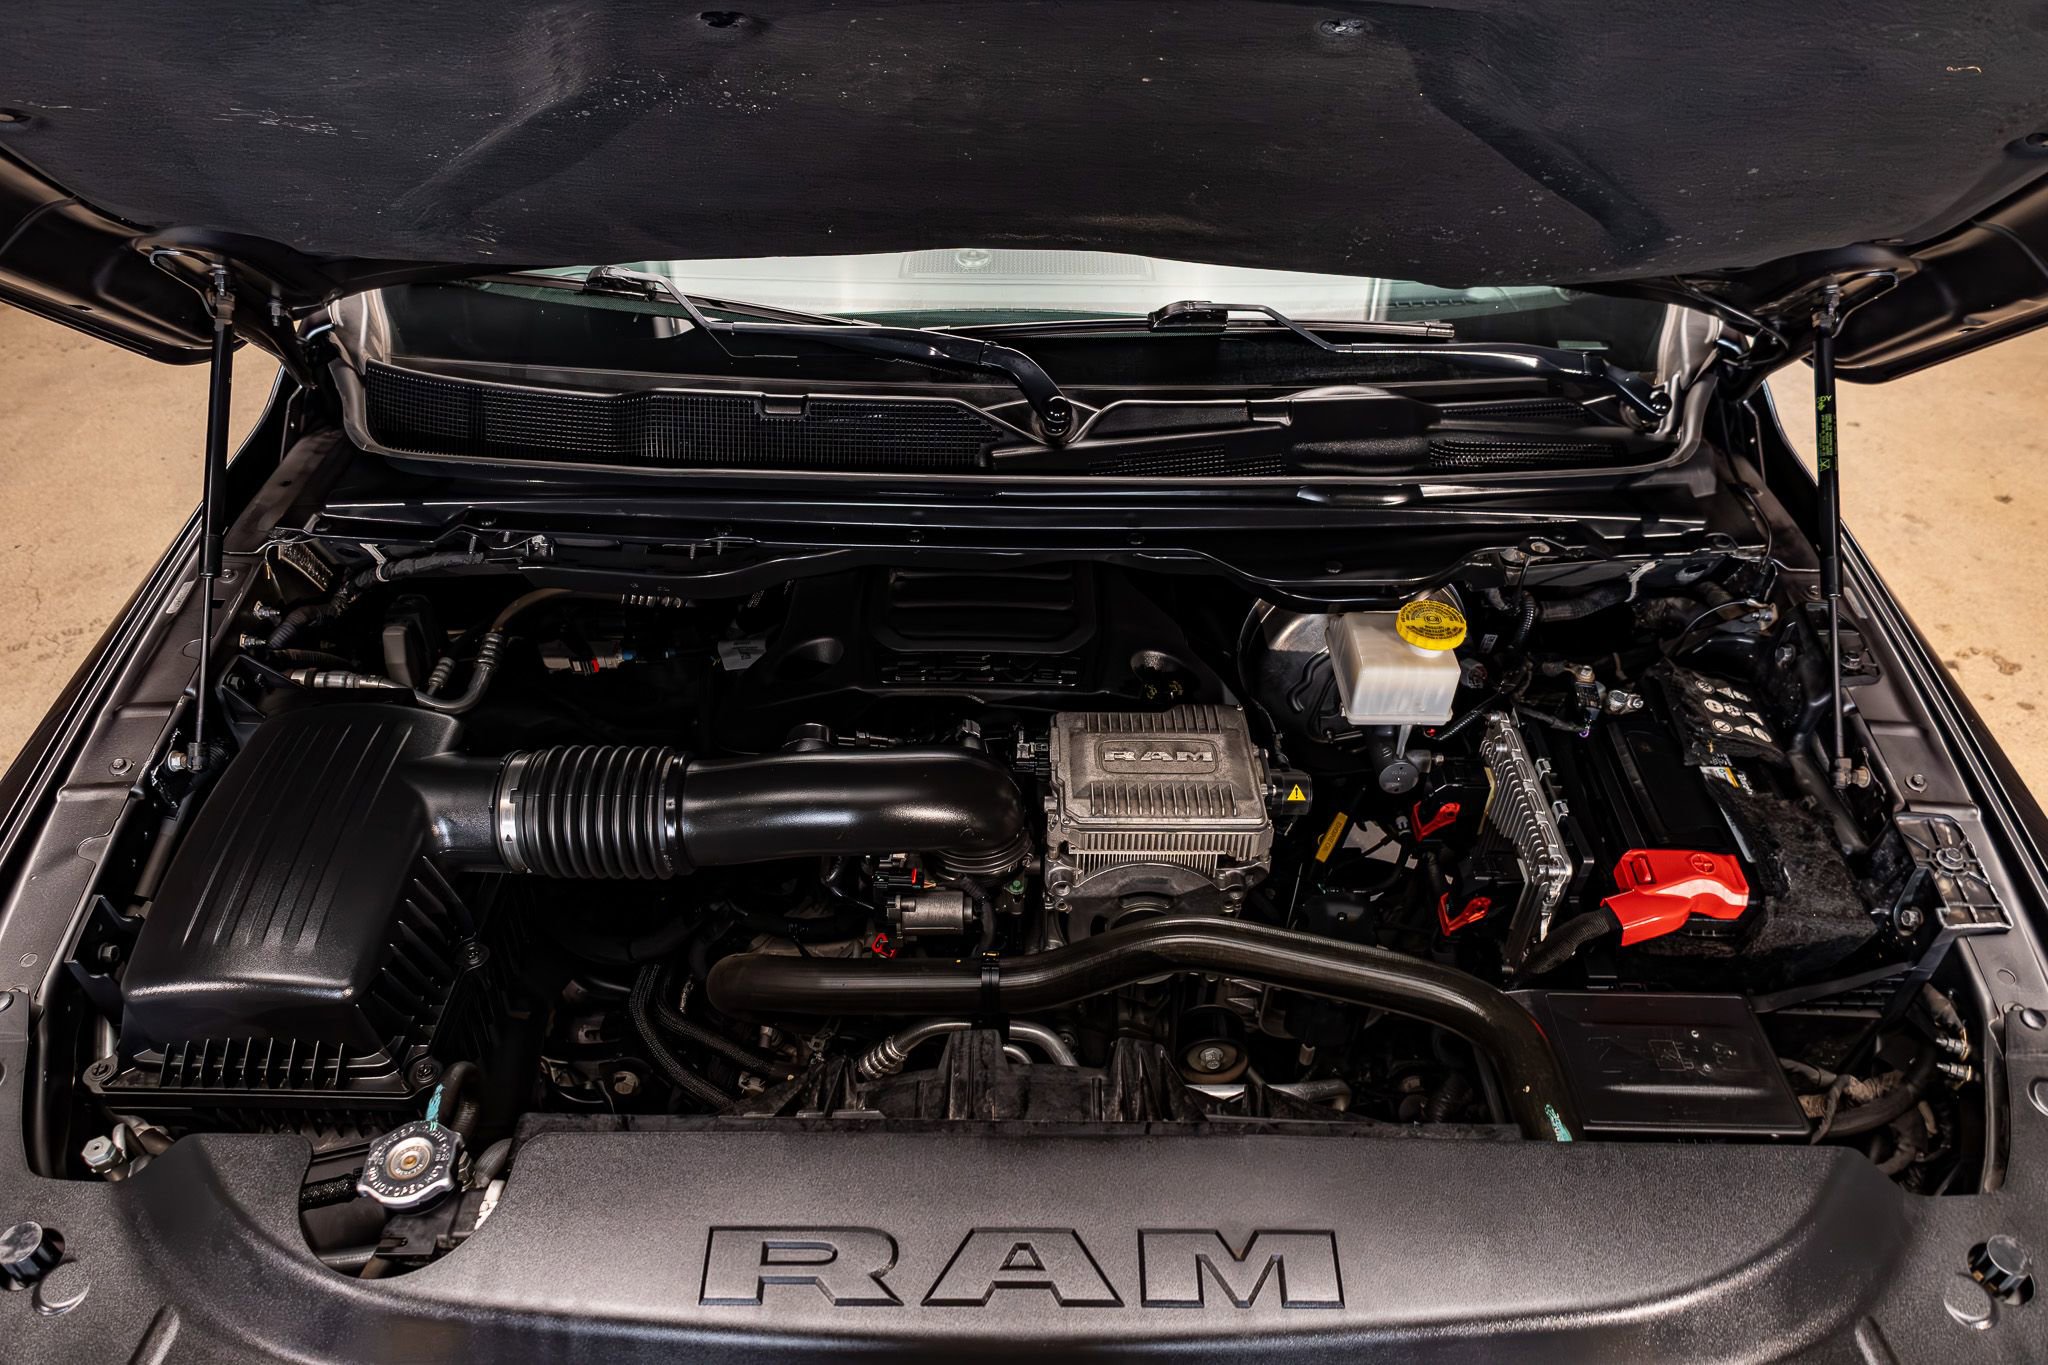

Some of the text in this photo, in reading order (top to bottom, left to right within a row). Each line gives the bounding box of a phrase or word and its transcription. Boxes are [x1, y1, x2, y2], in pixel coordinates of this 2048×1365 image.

[1104, 751, 1213, 762] RAM
[384, 1126, 416, 1146] KEEP
[393, 1183, 425, 1197] OPEN
[425, 1164, 443, 1183] HOT
[698, 1225, 1346, 1309] RAM
